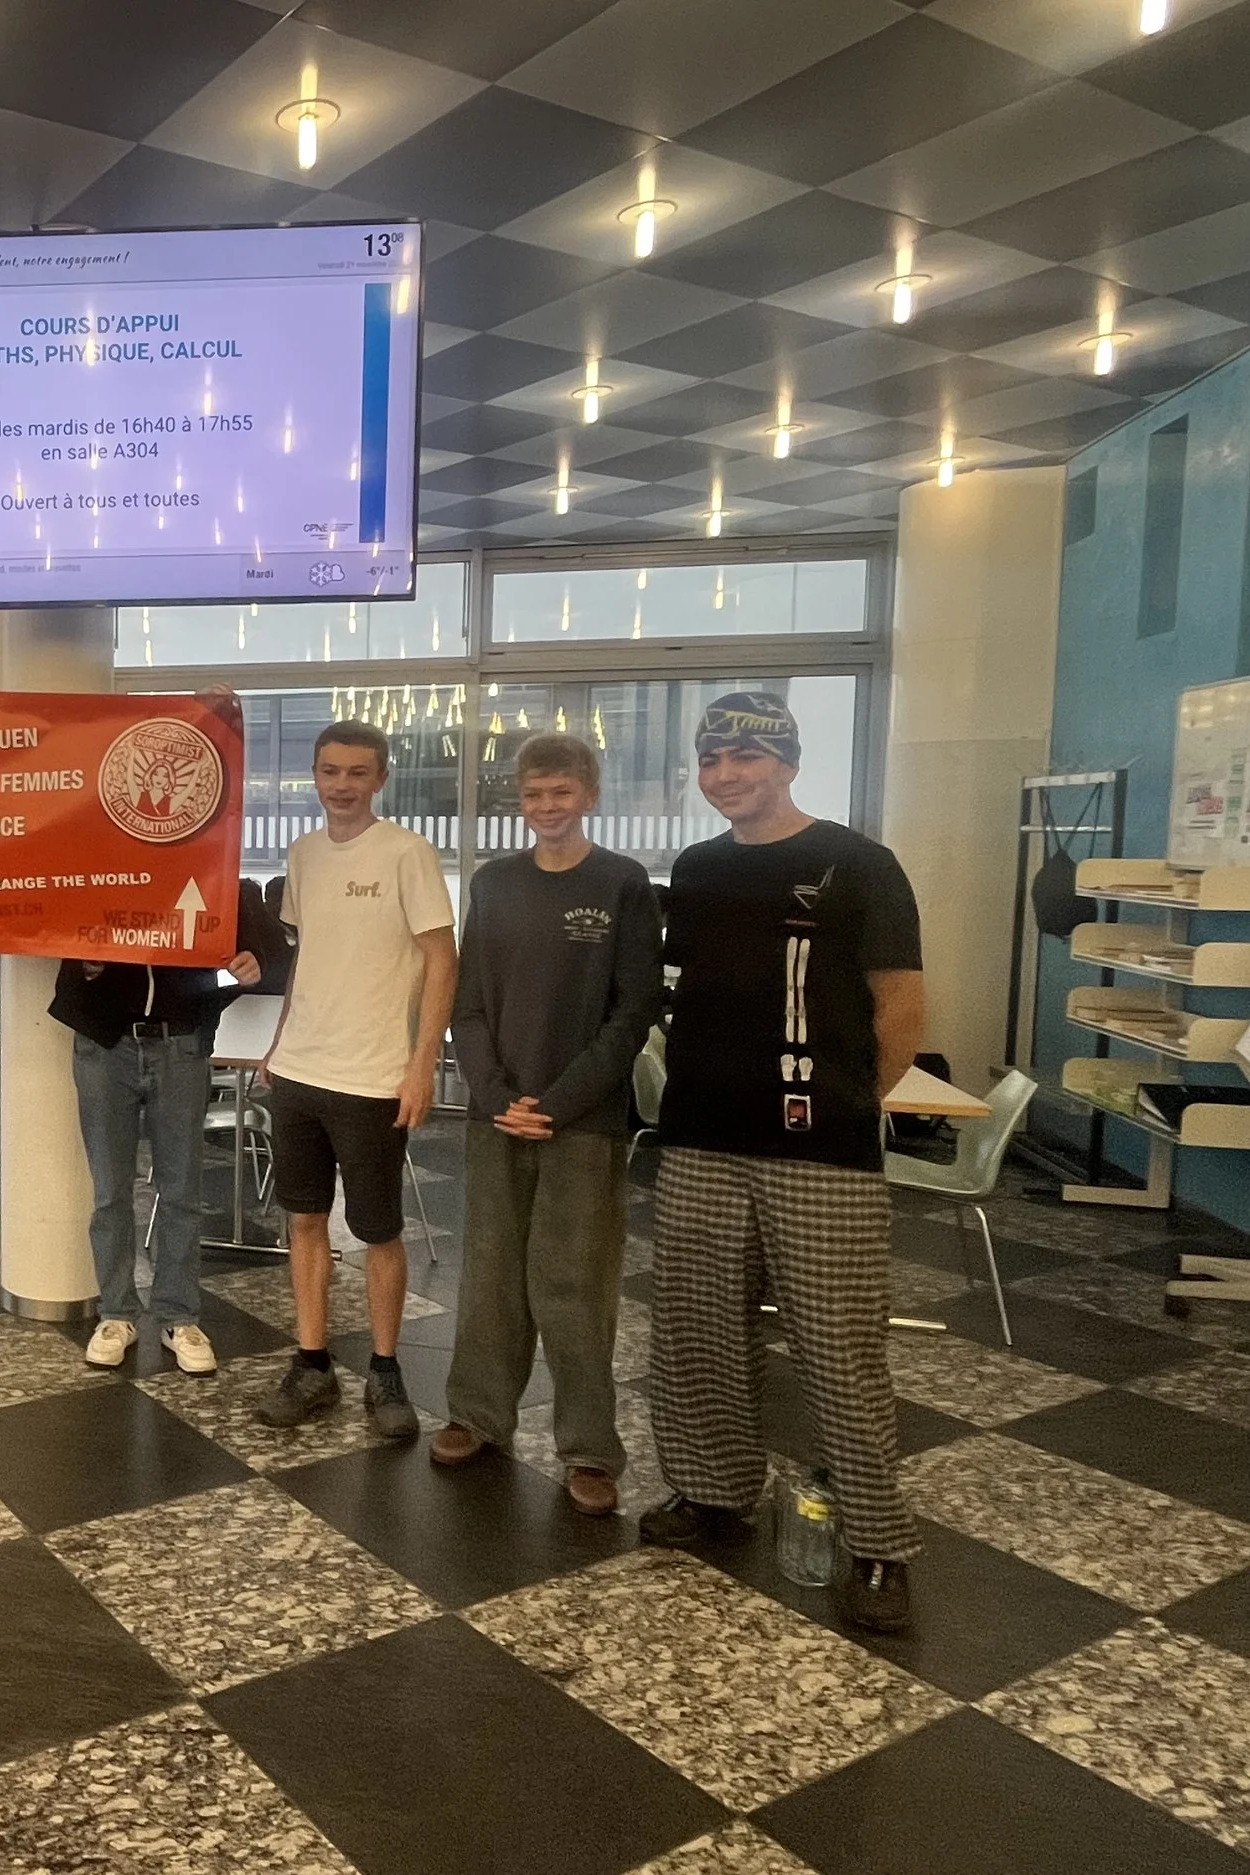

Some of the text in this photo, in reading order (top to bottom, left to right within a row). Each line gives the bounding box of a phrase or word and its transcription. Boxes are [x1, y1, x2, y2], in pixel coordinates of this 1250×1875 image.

[23, 256, 52, 267] notre
[55, 253, 121, 270] engagement
[20, 314, 179, 335] COURS D'APPUI
[160, 340, 243, 359] CALCUL
[28, 419, 88, 436] mardis
[94, 419, 116, 434] de
[122, 416, 176, 433] 16h40
[182, 416, 192, 432] à
[199, 415, 253, 431] 17h55
[41, 442, 158, 460] en salle A304
[1, 491, 200, 510] Ouvert à tous et toutes
[303, 523, 328, 533] CPNE
[247, 569, 274, 579] Mardi
[134, 734, 203, 760] SOROPTIMIST
[0, 770, 84, 793] FEMMES
[112, 800, 193, 834] INTERNATIONAL
[52, 875, 86, 888] THE
[90, 872, 151, 886] WORLD
[345, 881, 381, 898] Surf.
[104, 910, 221, 932] WE STAND UP
[77, 926, 176, 949] FOR WOMEN!
